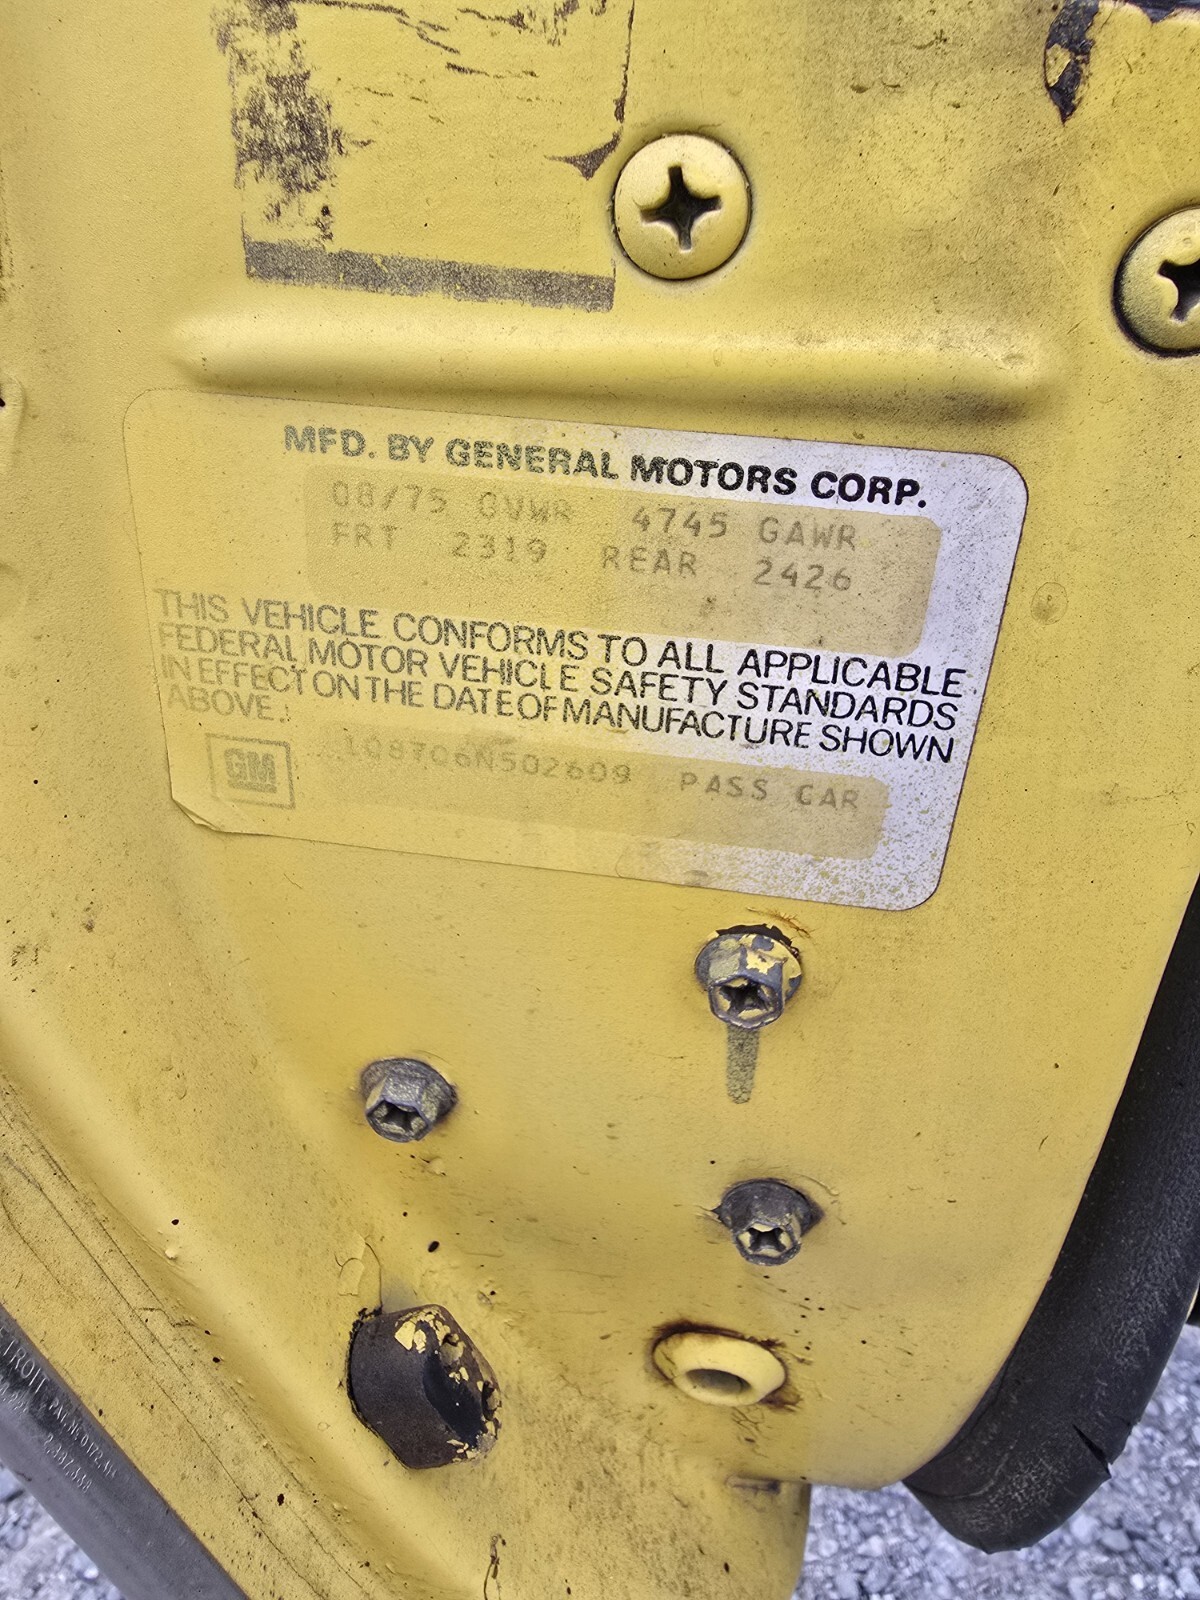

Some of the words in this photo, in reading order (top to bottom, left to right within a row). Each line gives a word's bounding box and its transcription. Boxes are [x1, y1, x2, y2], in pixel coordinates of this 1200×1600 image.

[283, 424, 376, 459] MFD.
[387, 433, 434, 463] BY
[445, 437, 618, 480] GENERAL
[630, 455, 798, 495] MOTORS
[810, 471, 926, 508] CORP.
[332, 480, 448, 514] 08/75
[478, 490, 574, 523] GVWR
[631, 506, 728, 539] 4745
[758, 516, 857, 551] GAWR
[332, 522, 399, 550] FRT
[452, 531, 547, 564] 2319
[602, 545, 697, 576] REAR
[754, 559, 852, 591] 2426
[153, 588, 230, 623] THIS
[240, 597, 381, 639] VEHICLE
[393, 612, 589, 660] CONFORMS
[597, 634, 648, 667] TO
[657, 641, 724, 674] ALL
[737, 648, 967, 698] APPLICABLE
[157, 622, 298, 662] FEDERAL
[308, 637, 429, 678] MOTOR
[438, 651, 579, 693] VEHICLE
[590, 666, 728, 706] SAFETY
[737, 681, 959, 731] STANDARDS
[160, 654, 192, 682] IN
[198, 657, 308, 696] EFFECT
[312, 669, 361, 701] ON
[364, 675, 425, 708] THE
[434, 684, 513, 717] DATE
[518, 693, 560, 723] OF
[561, 697, 809, 749] MANUFACTURE
[819, 724, 954, 764] SHOWN
[167, 683, 287, 723] ABOVE.
[223, 748, 277, 783] GM
[680, 771, 769, 802] PASS
[795, 783, 859, 810] CAR
